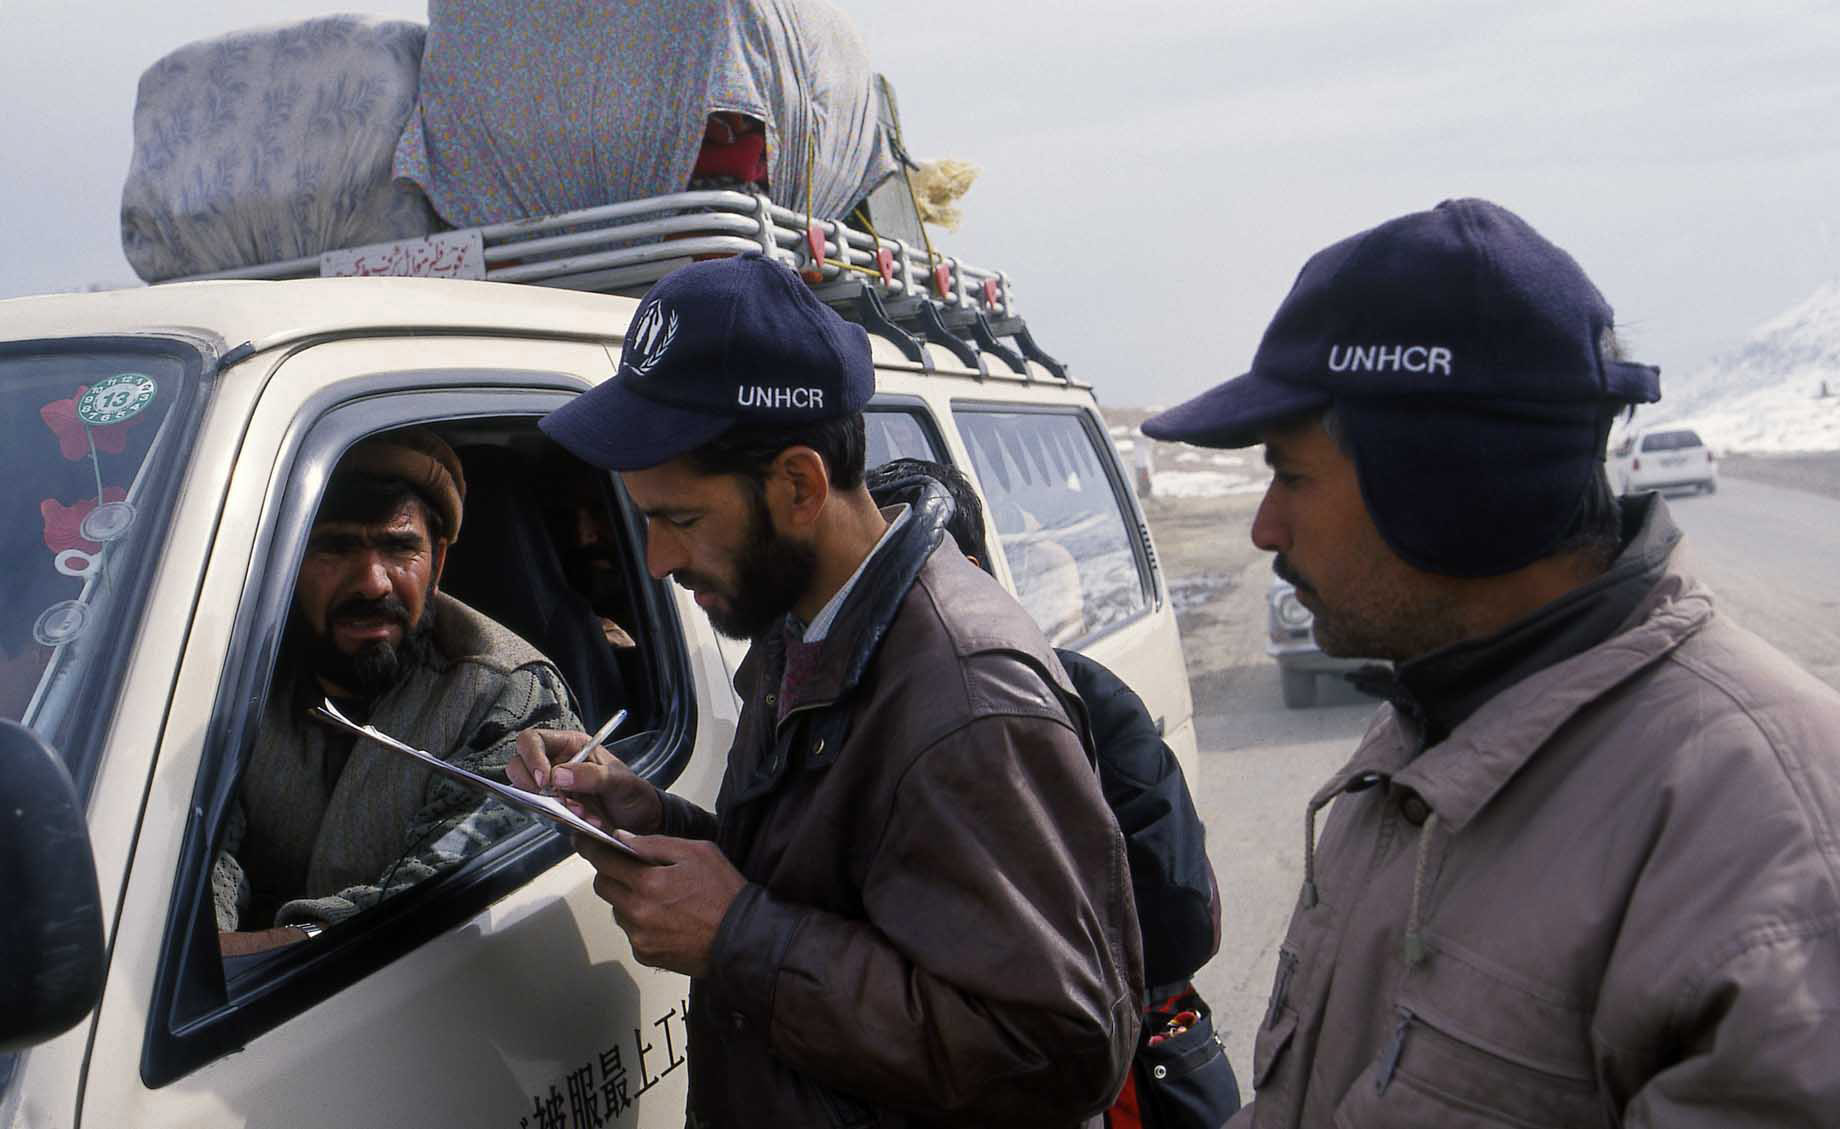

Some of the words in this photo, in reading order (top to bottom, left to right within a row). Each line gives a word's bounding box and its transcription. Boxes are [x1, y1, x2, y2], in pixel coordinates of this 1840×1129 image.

[1327, 344, 1453, 376] UNHCR
[107, 378, 117, 386] 11
[136, 377, 144, 386] 1
[84, 396, 94, 404] 9
[103, 391, 130, 408] 13
[139, 393, 150, 401] 3
[737, 384, 824, 409] UNHCR
[89, 412, 98, 420] 7
